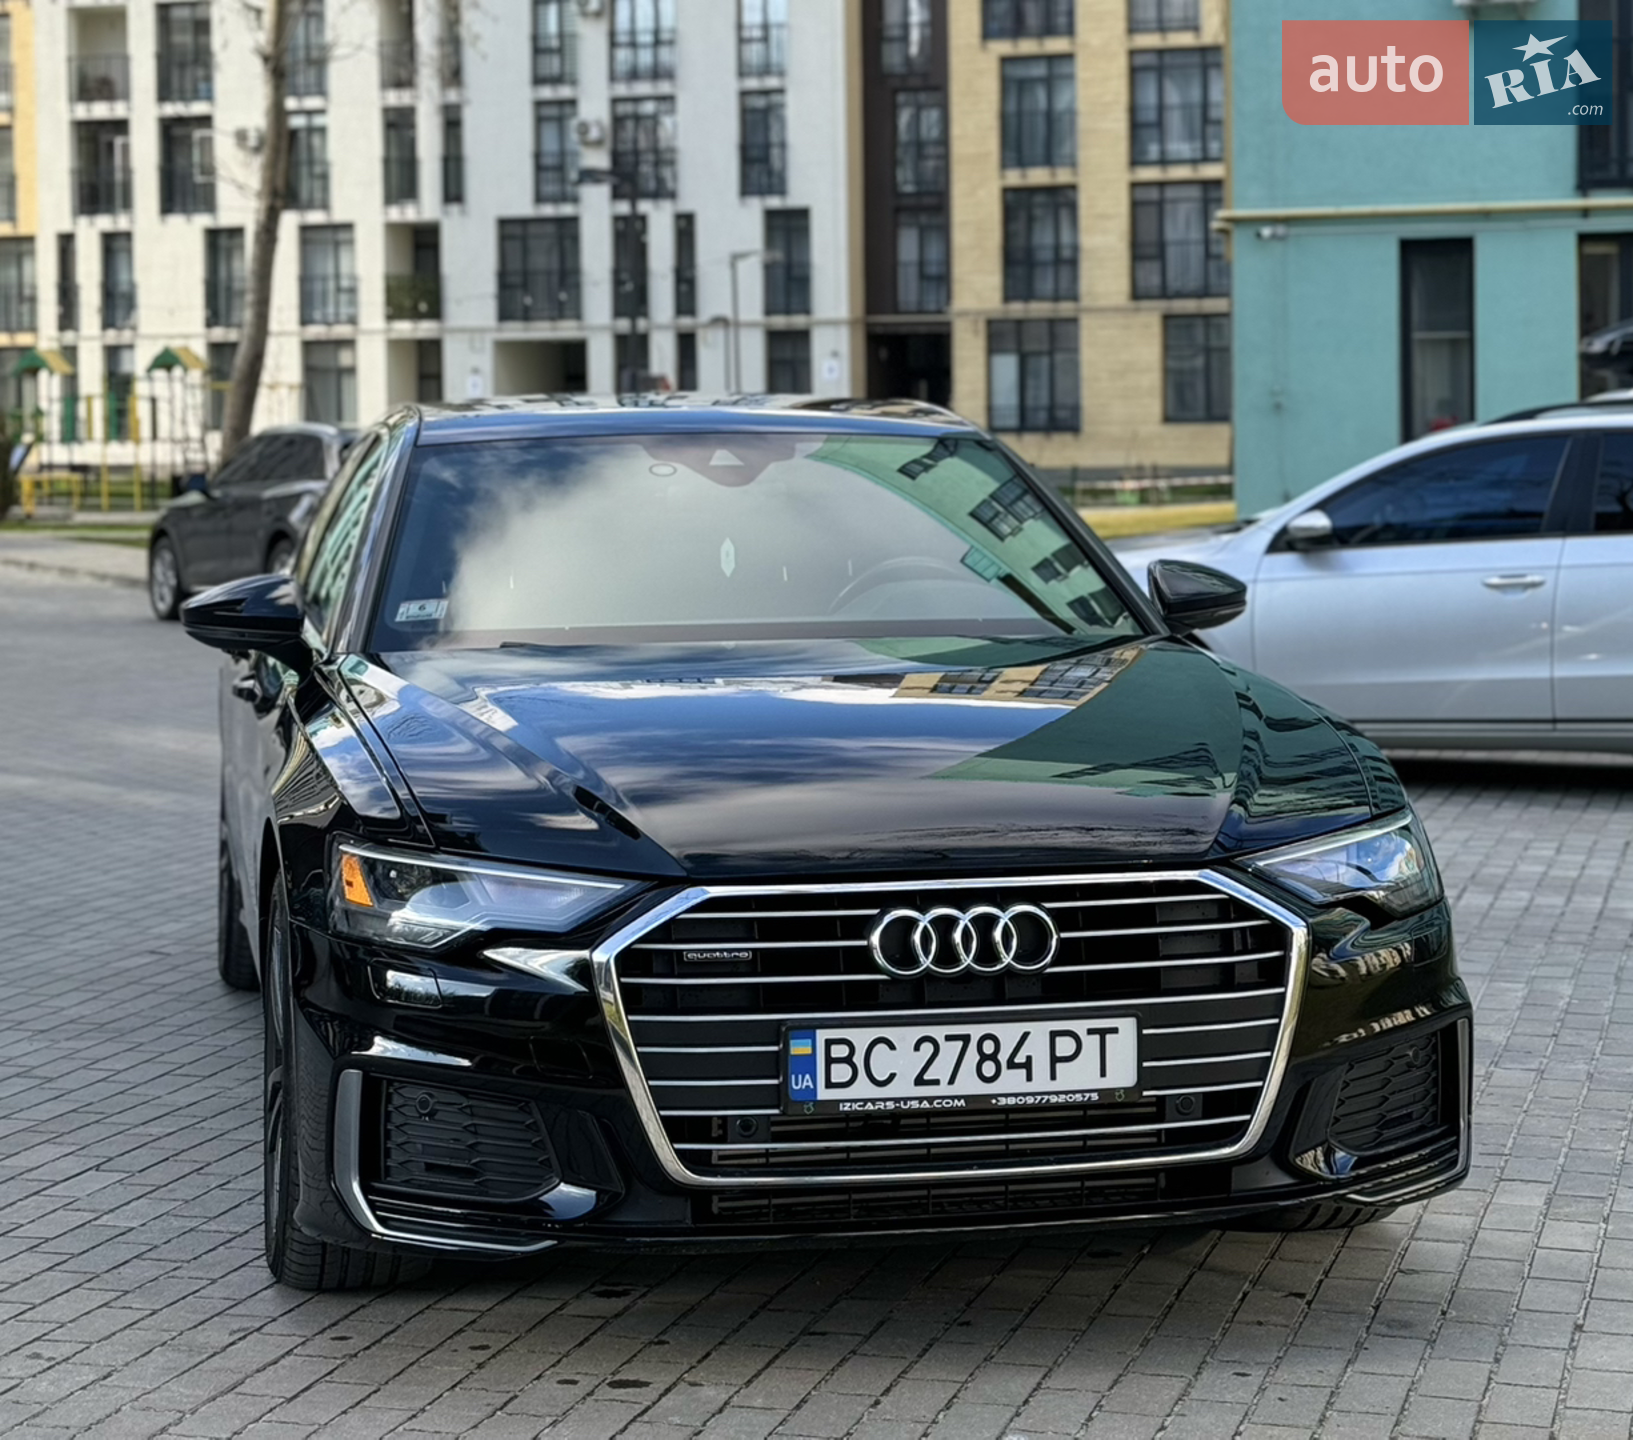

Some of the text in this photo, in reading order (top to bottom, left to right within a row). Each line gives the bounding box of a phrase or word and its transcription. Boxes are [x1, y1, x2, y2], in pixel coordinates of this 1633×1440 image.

[687, 951, 749, 961] quattro
[824, 1027, 1119, 1088] BC 2784 PT
[791, 1073, 814, 1090] UA
[839, 1092, 1099, 1112] IZICARS-USA.COM +380977920575
